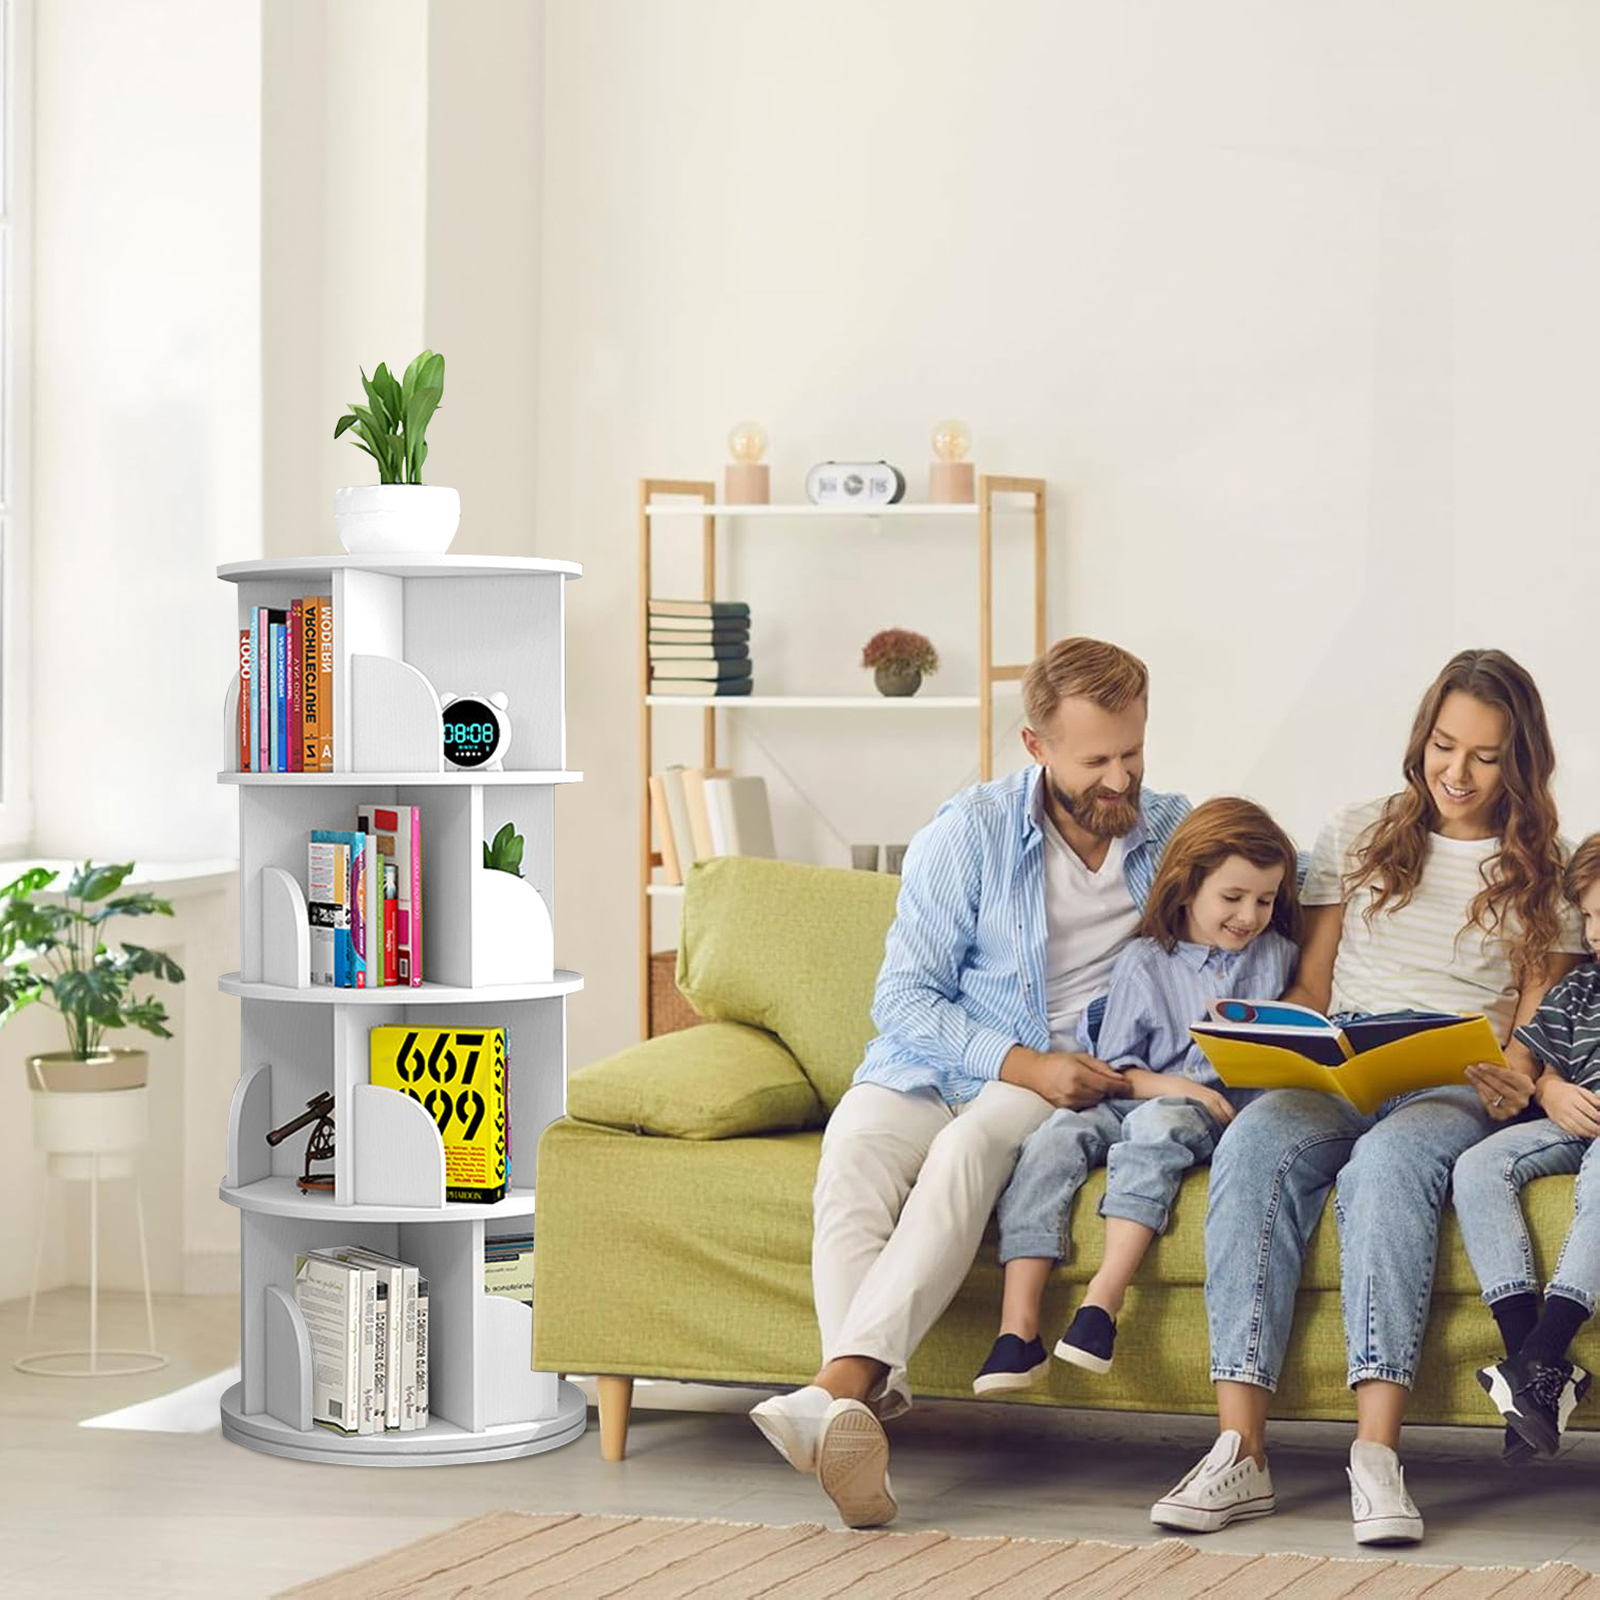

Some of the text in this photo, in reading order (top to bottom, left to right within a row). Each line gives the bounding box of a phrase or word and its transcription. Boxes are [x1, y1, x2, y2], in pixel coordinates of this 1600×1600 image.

[443, 723, 493, 743] 08:08
[396, 1032, 485, 1085] 667
[399, 1087, 486, 1141] 99
